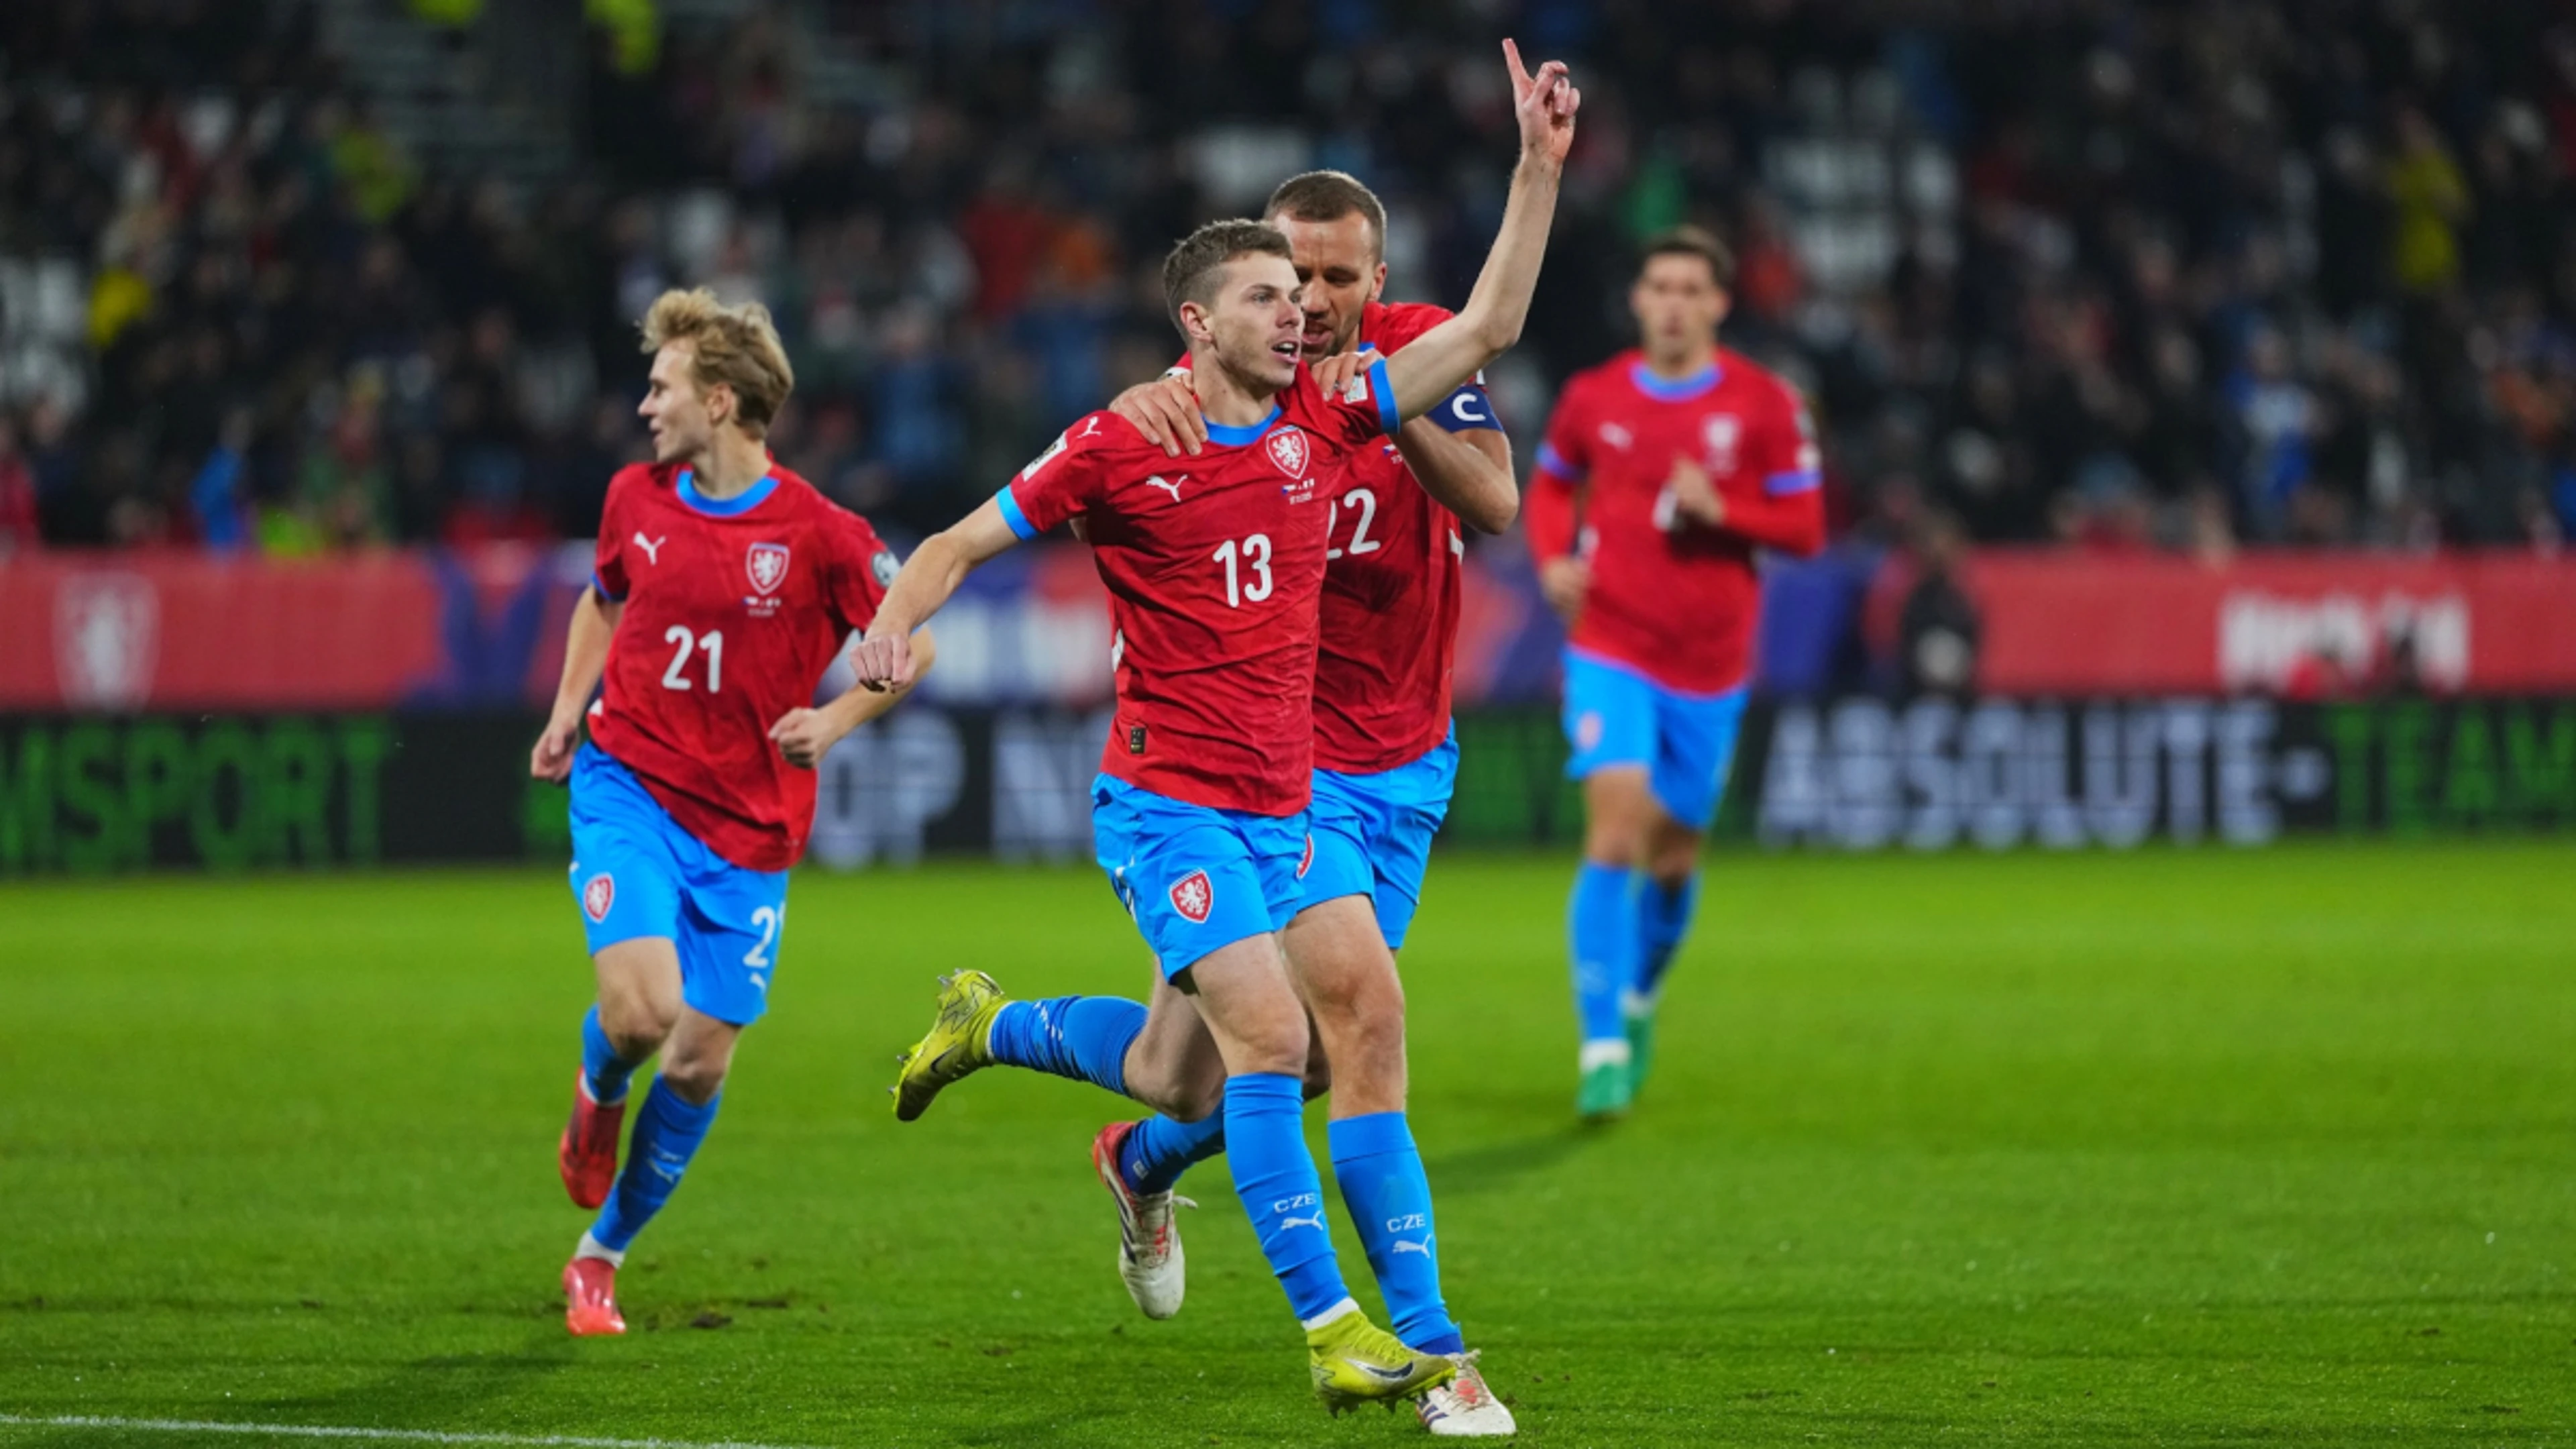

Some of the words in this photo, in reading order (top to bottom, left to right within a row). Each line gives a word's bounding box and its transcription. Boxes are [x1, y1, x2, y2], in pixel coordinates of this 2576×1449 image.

[1452, 393, 1486, 421] C
[1212, 533, 1273, 608] 13
[661, 625, 722, 694] 21
[1274, 1192, 1316, 1214] CZE
[1386, 1213, 1426, 1233] CZE
